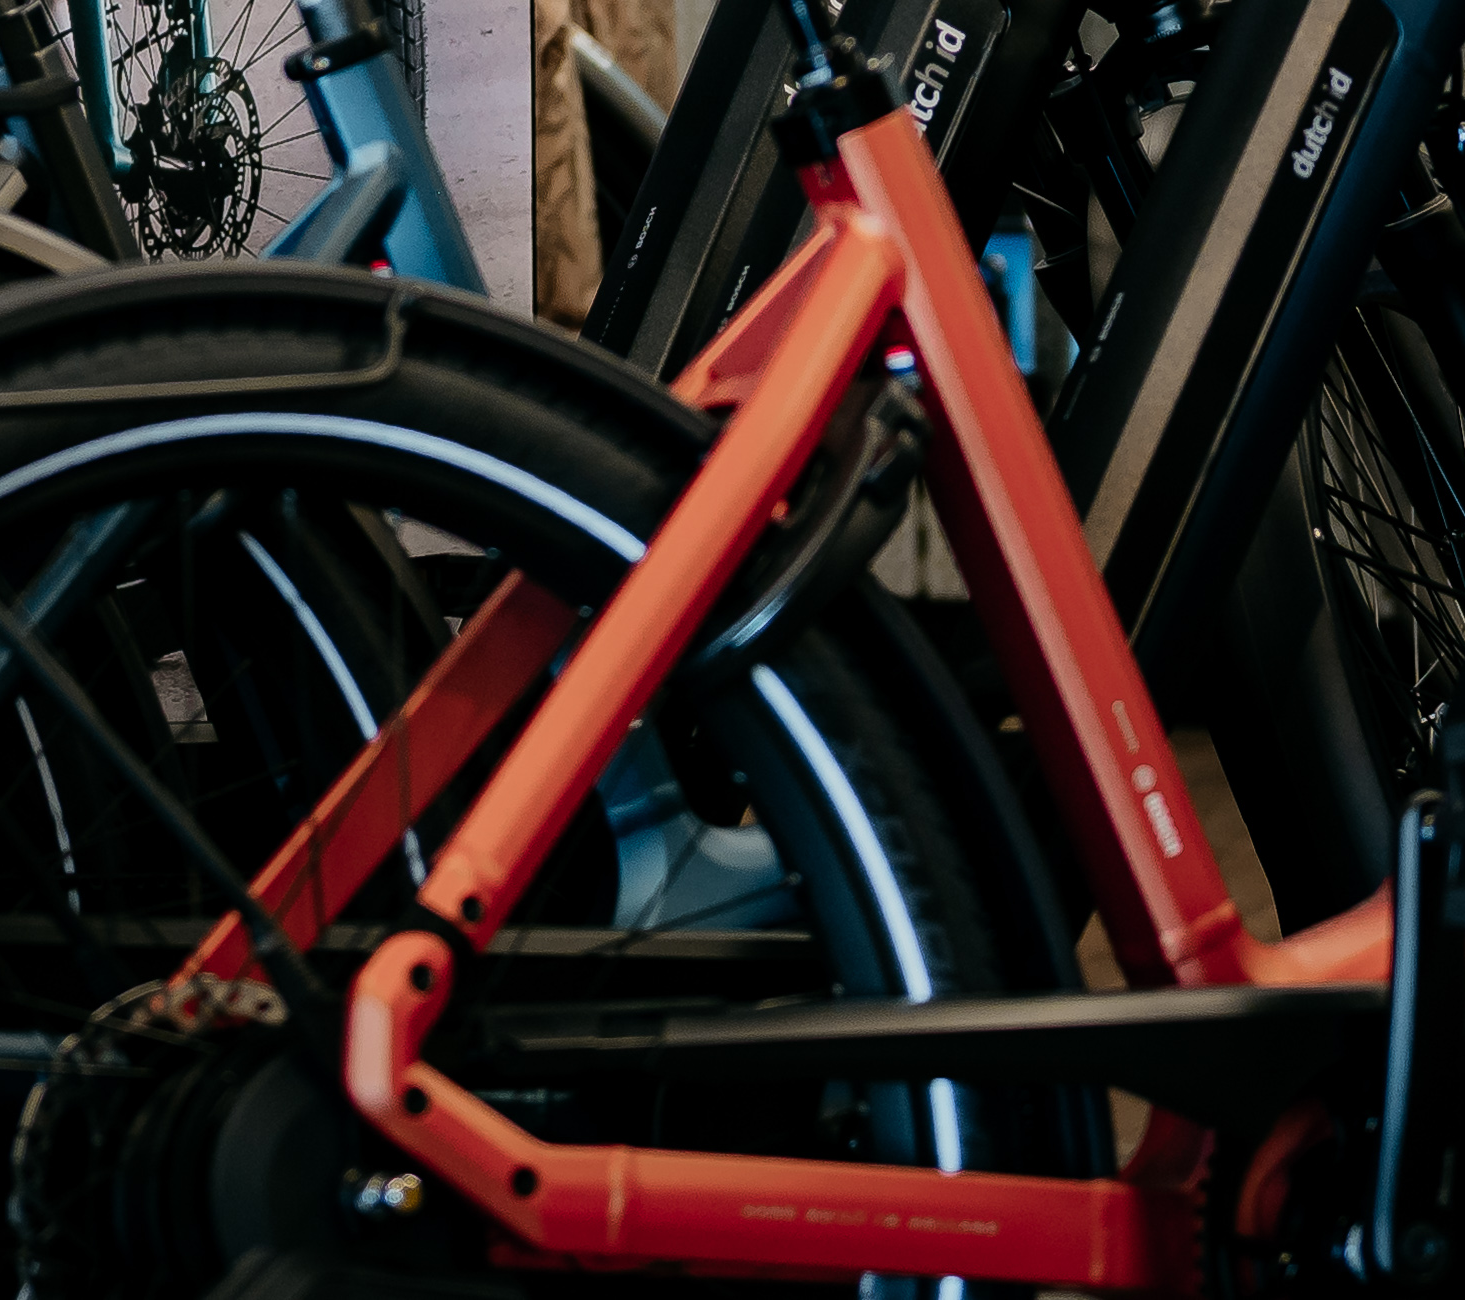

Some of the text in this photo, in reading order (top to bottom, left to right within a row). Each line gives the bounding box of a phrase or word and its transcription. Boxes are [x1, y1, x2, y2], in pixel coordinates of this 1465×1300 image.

[914, 18, 967, 132] tch id
[1291, 65, 1353, 179] dutch id
[635, 206, 658, 250] BOSCH
